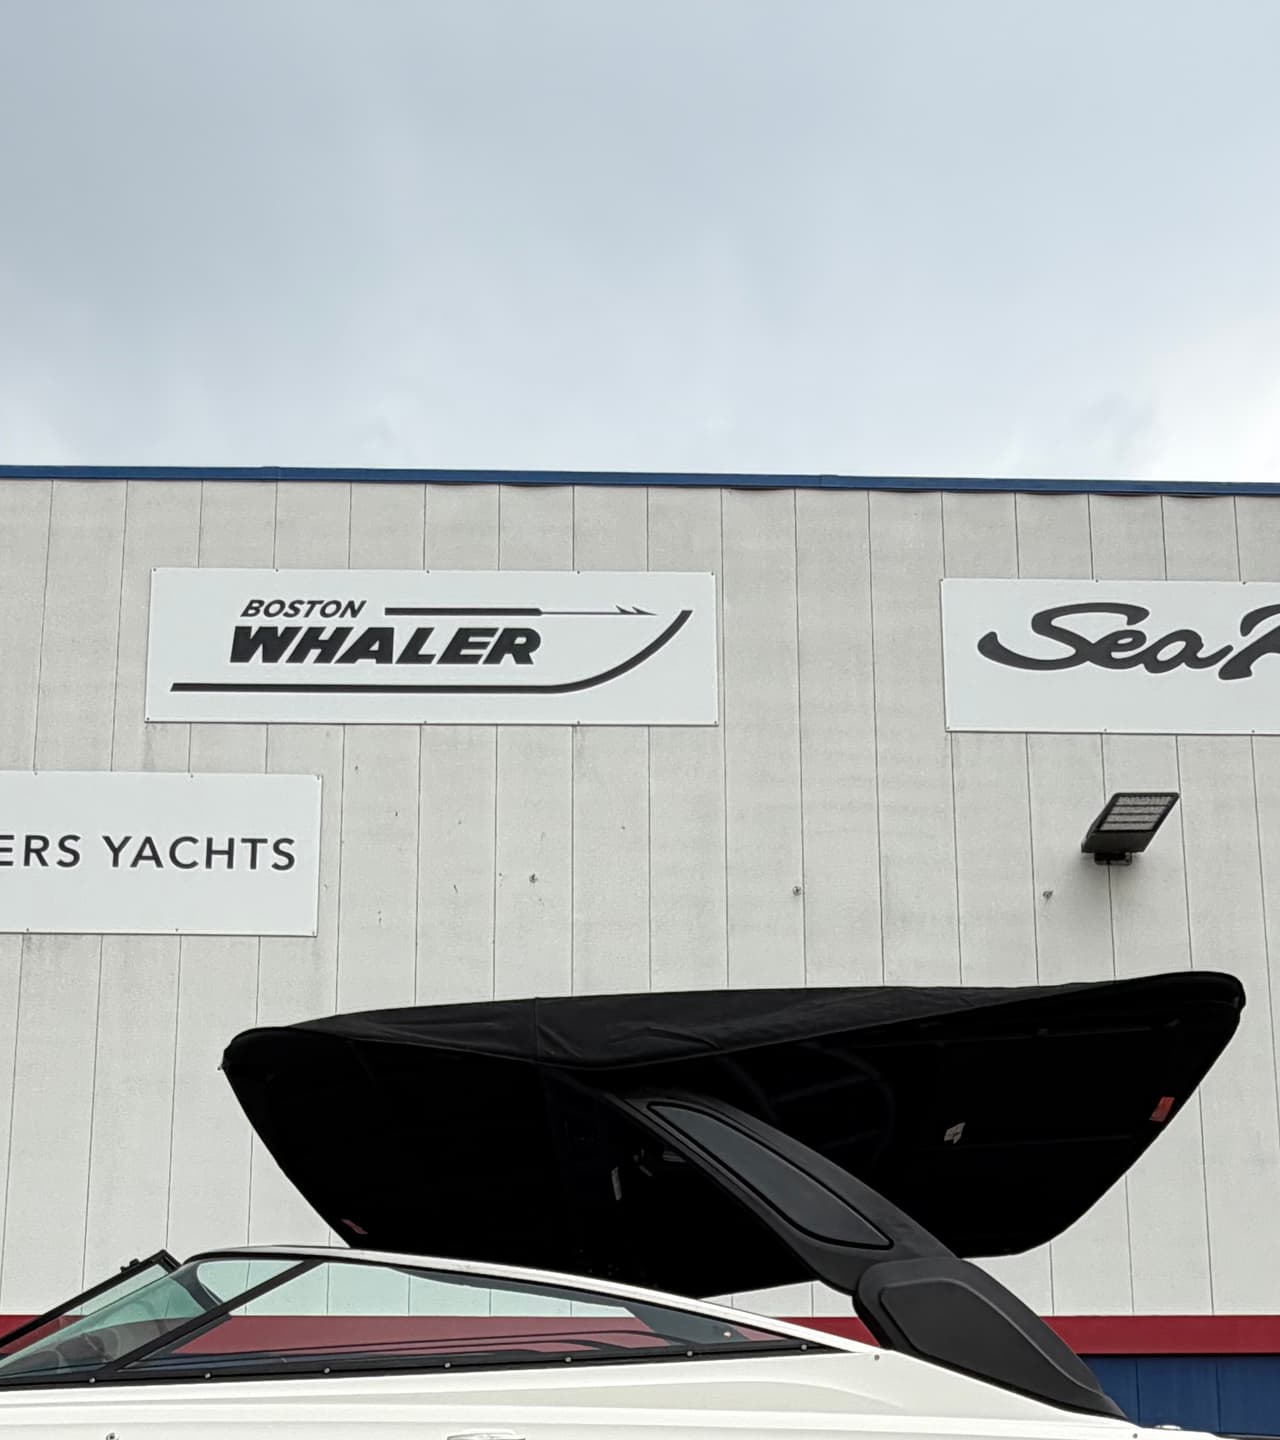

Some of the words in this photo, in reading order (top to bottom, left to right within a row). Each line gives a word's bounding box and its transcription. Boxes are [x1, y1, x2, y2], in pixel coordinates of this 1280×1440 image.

[240, 599, 367, 618] BOSTON
[229, 625, 542, 665] WHALER
[977, 602, 1234, 675] Sea
[102, 835, 296, 871] YACHTS
